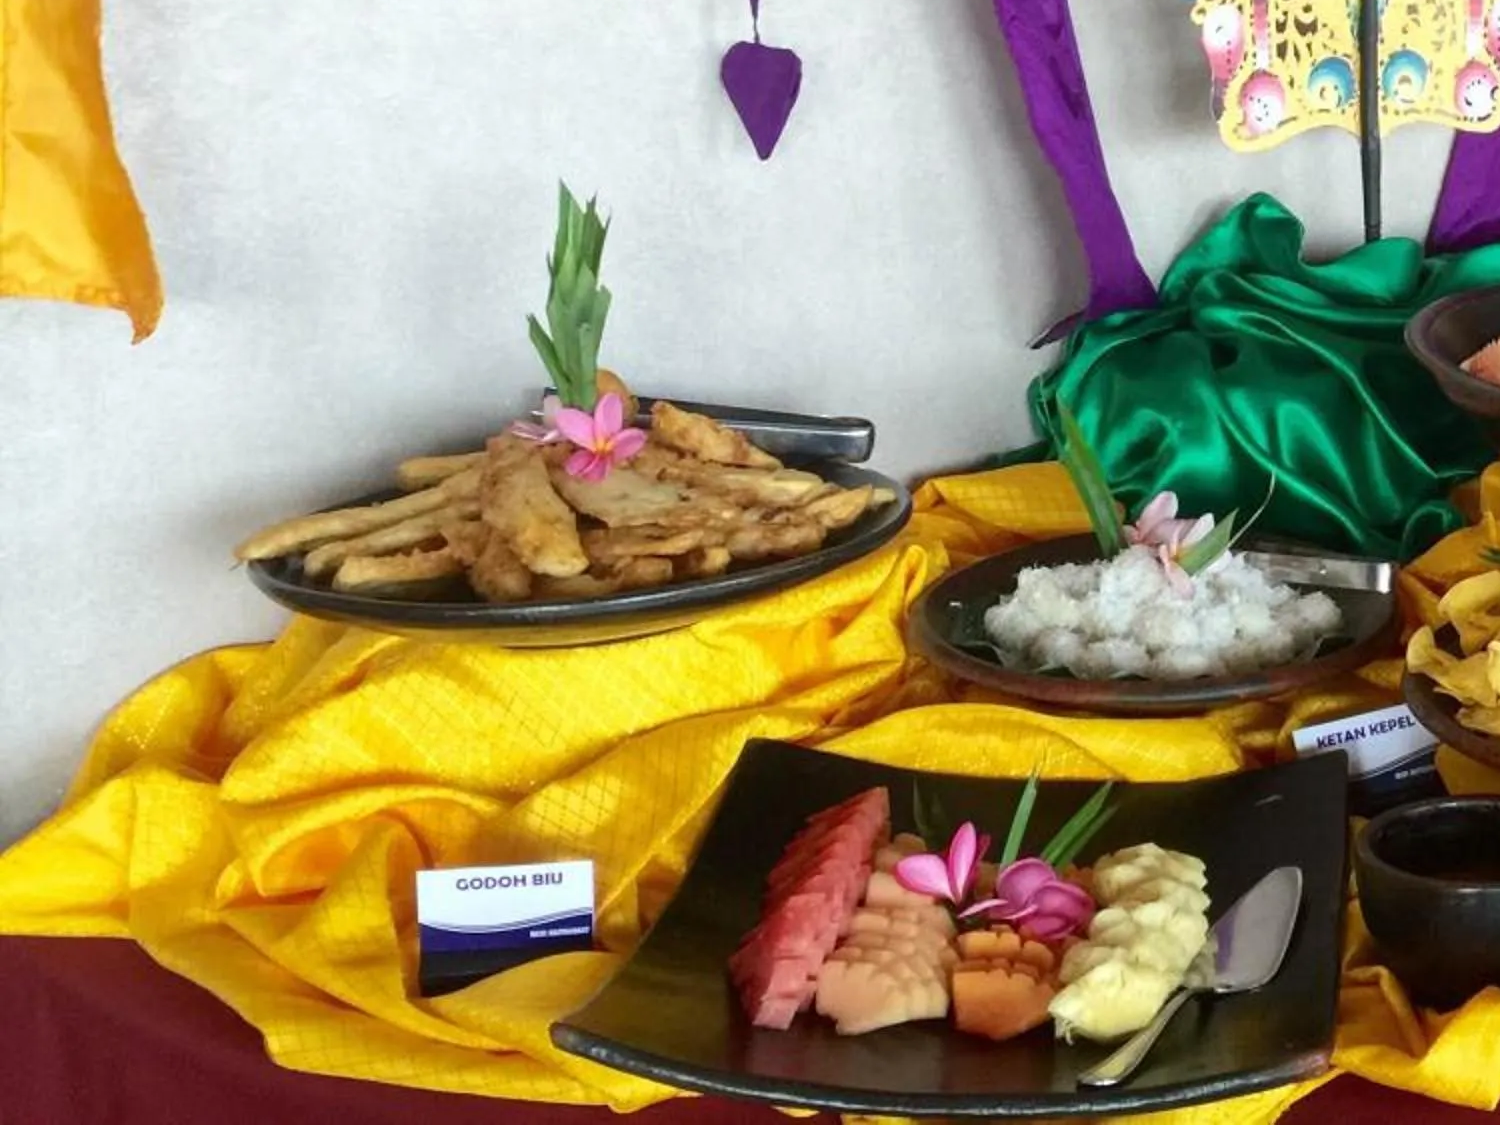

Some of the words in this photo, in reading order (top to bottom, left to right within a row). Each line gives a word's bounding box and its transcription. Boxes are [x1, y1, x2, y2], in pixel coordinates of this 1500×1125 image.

[1315, 726, 1366, 749] KETAN
[1368, 715, 1416, 736] KEPEL
[455, 875, 527, 891] GODOH
[532, 872, 563, 886] BIU
